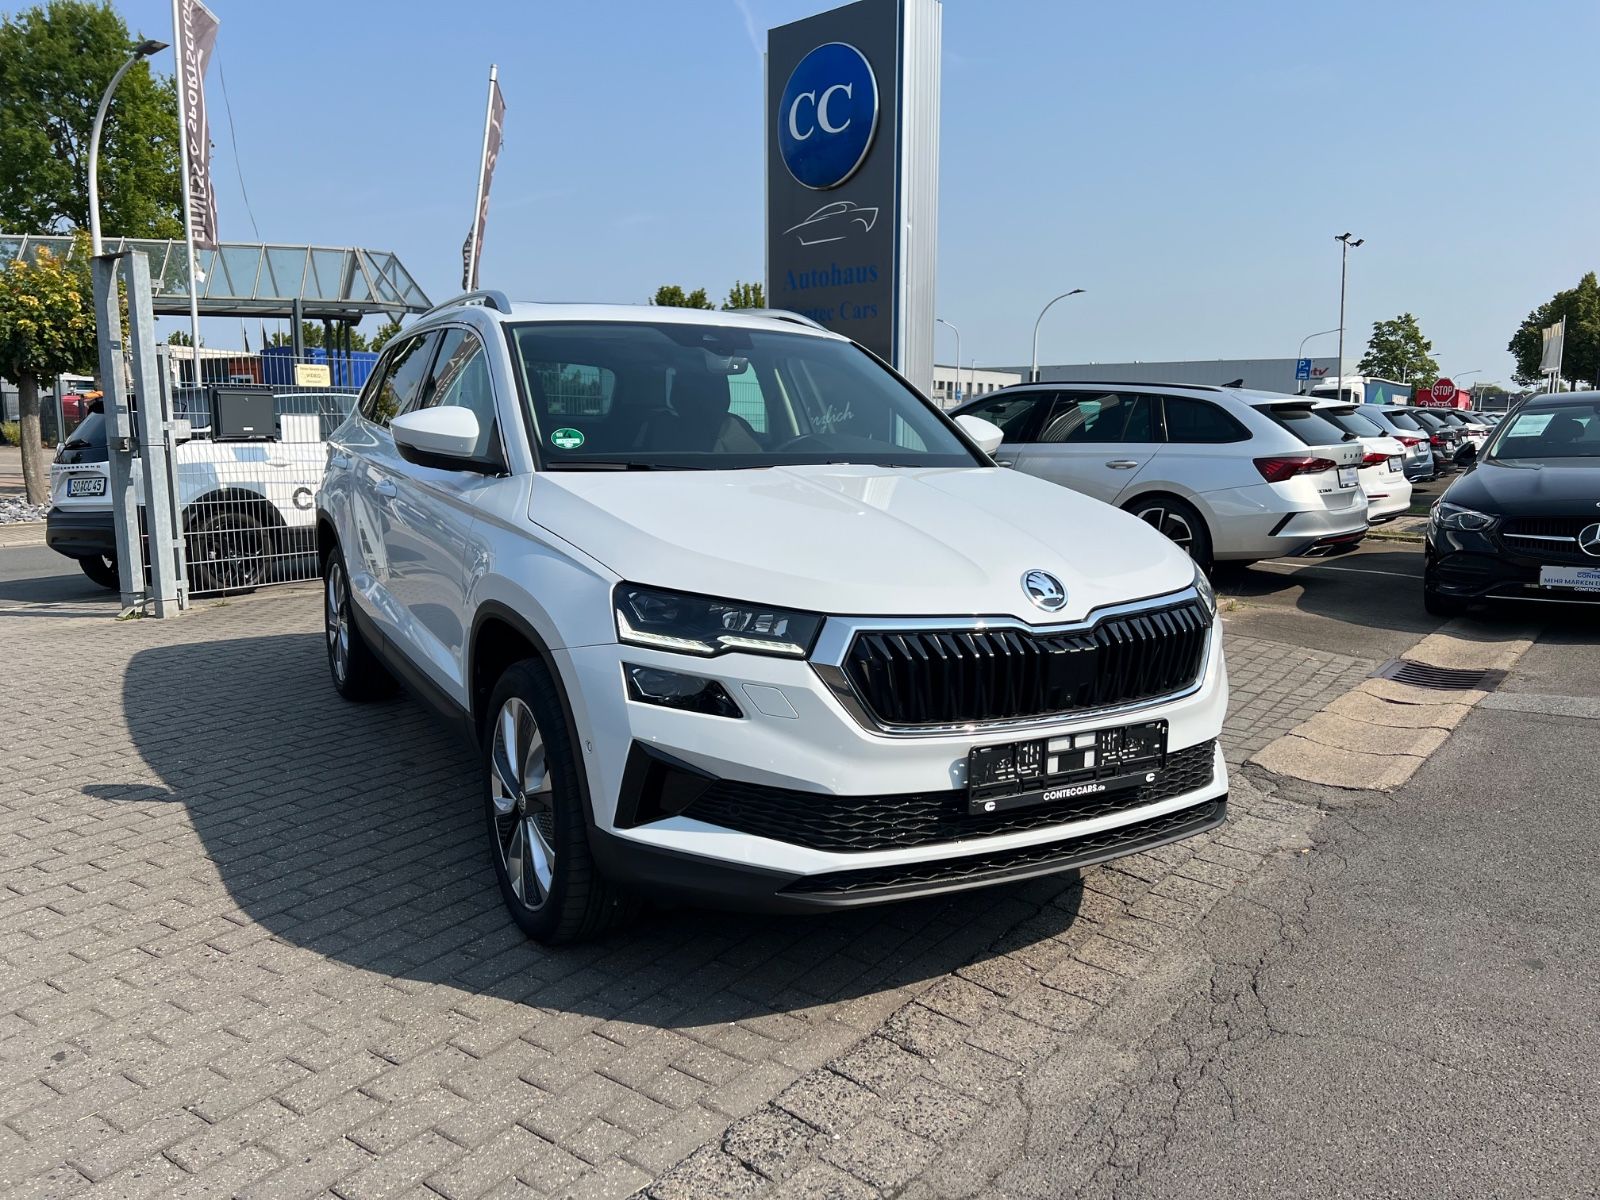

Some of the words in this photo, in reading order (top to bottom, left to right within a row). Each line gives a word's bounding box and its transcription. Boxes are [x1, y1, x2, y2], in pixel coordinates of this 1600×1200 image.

[789, 83, 852, 141] CC
[783, 262, 879, 291] Autohaus
[840, 301, 879, 320] Cars
[1433, 385, 1453, 396] STOP
[1043, 783, 1106, 801] CONTECCARS.de
